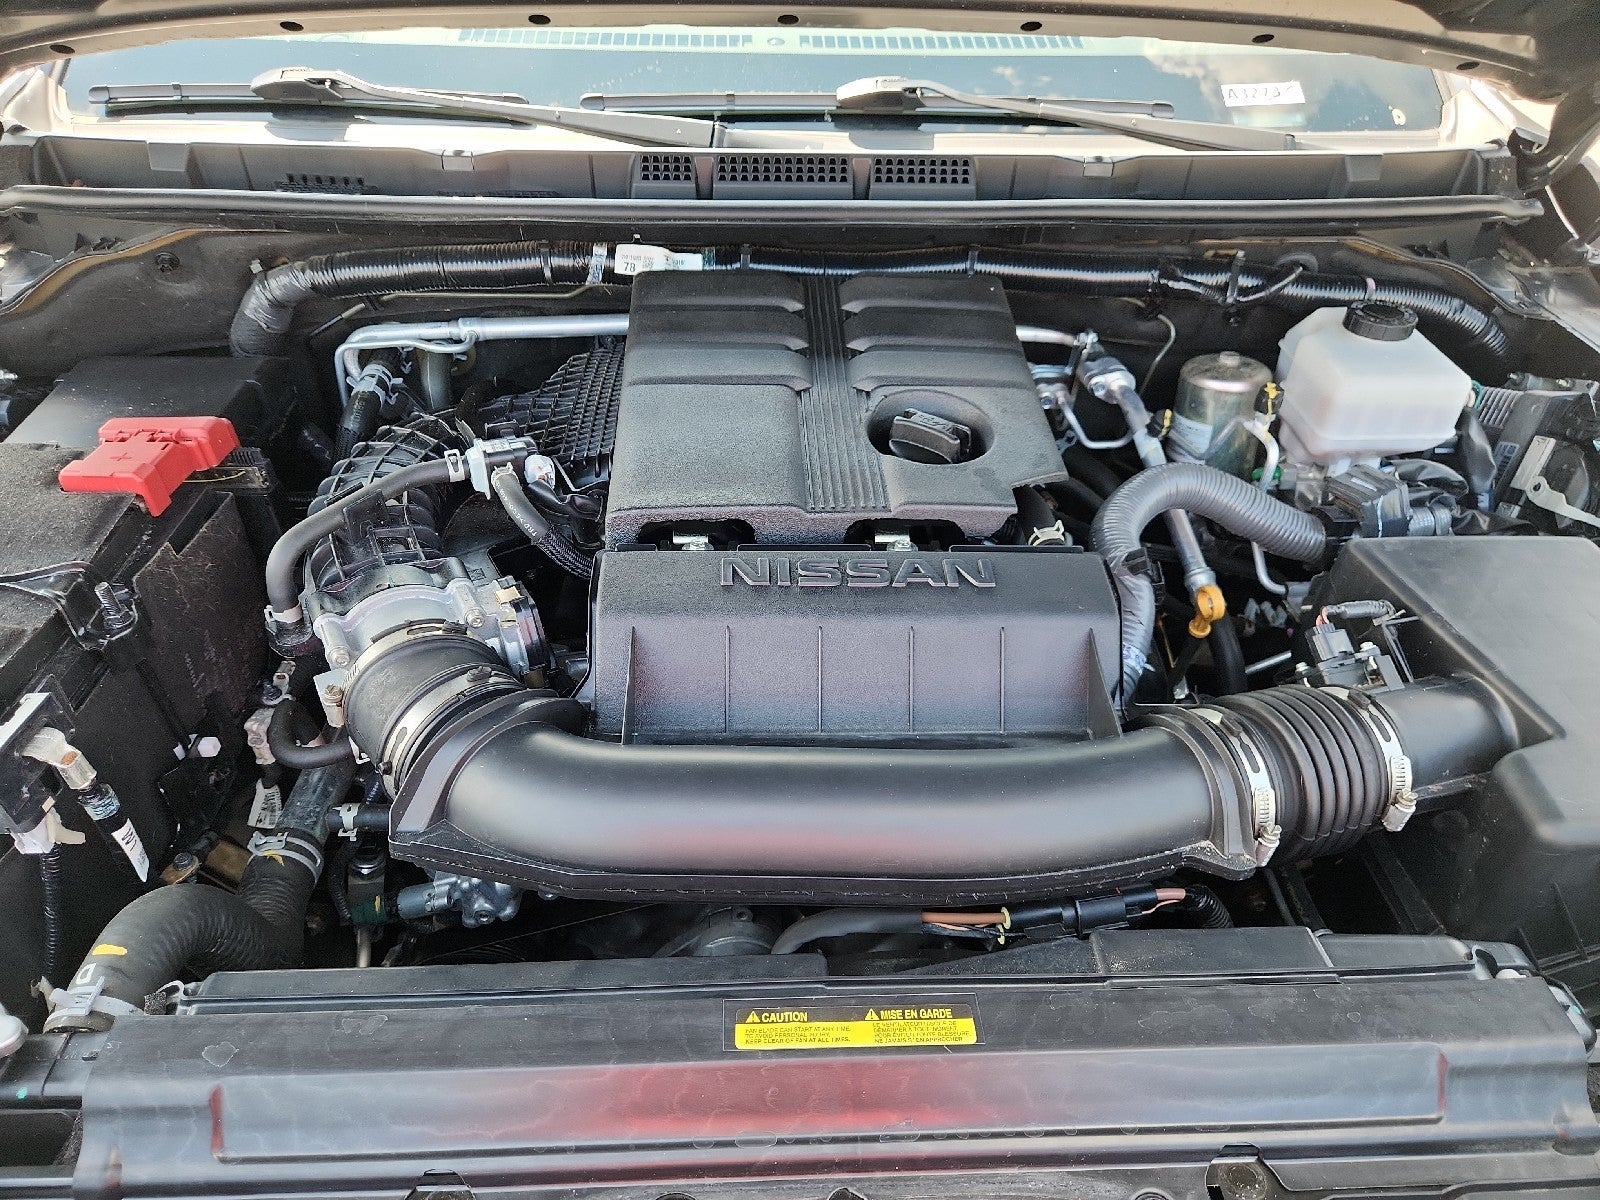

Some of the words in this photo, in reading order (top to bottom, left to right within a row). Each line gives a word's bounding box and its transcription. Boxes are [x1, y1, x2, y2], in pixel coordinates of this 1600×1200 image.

[624, 262, 636, 272] 78
[720, 557, 996, 588] NISSAN
[761, 1011, 808, 1023] CAUTION
[880, 1009, 904, 1020] MISE
[905, 1009, 918, 1020] EN
[919, 1008, 953, 1019] GARDE
